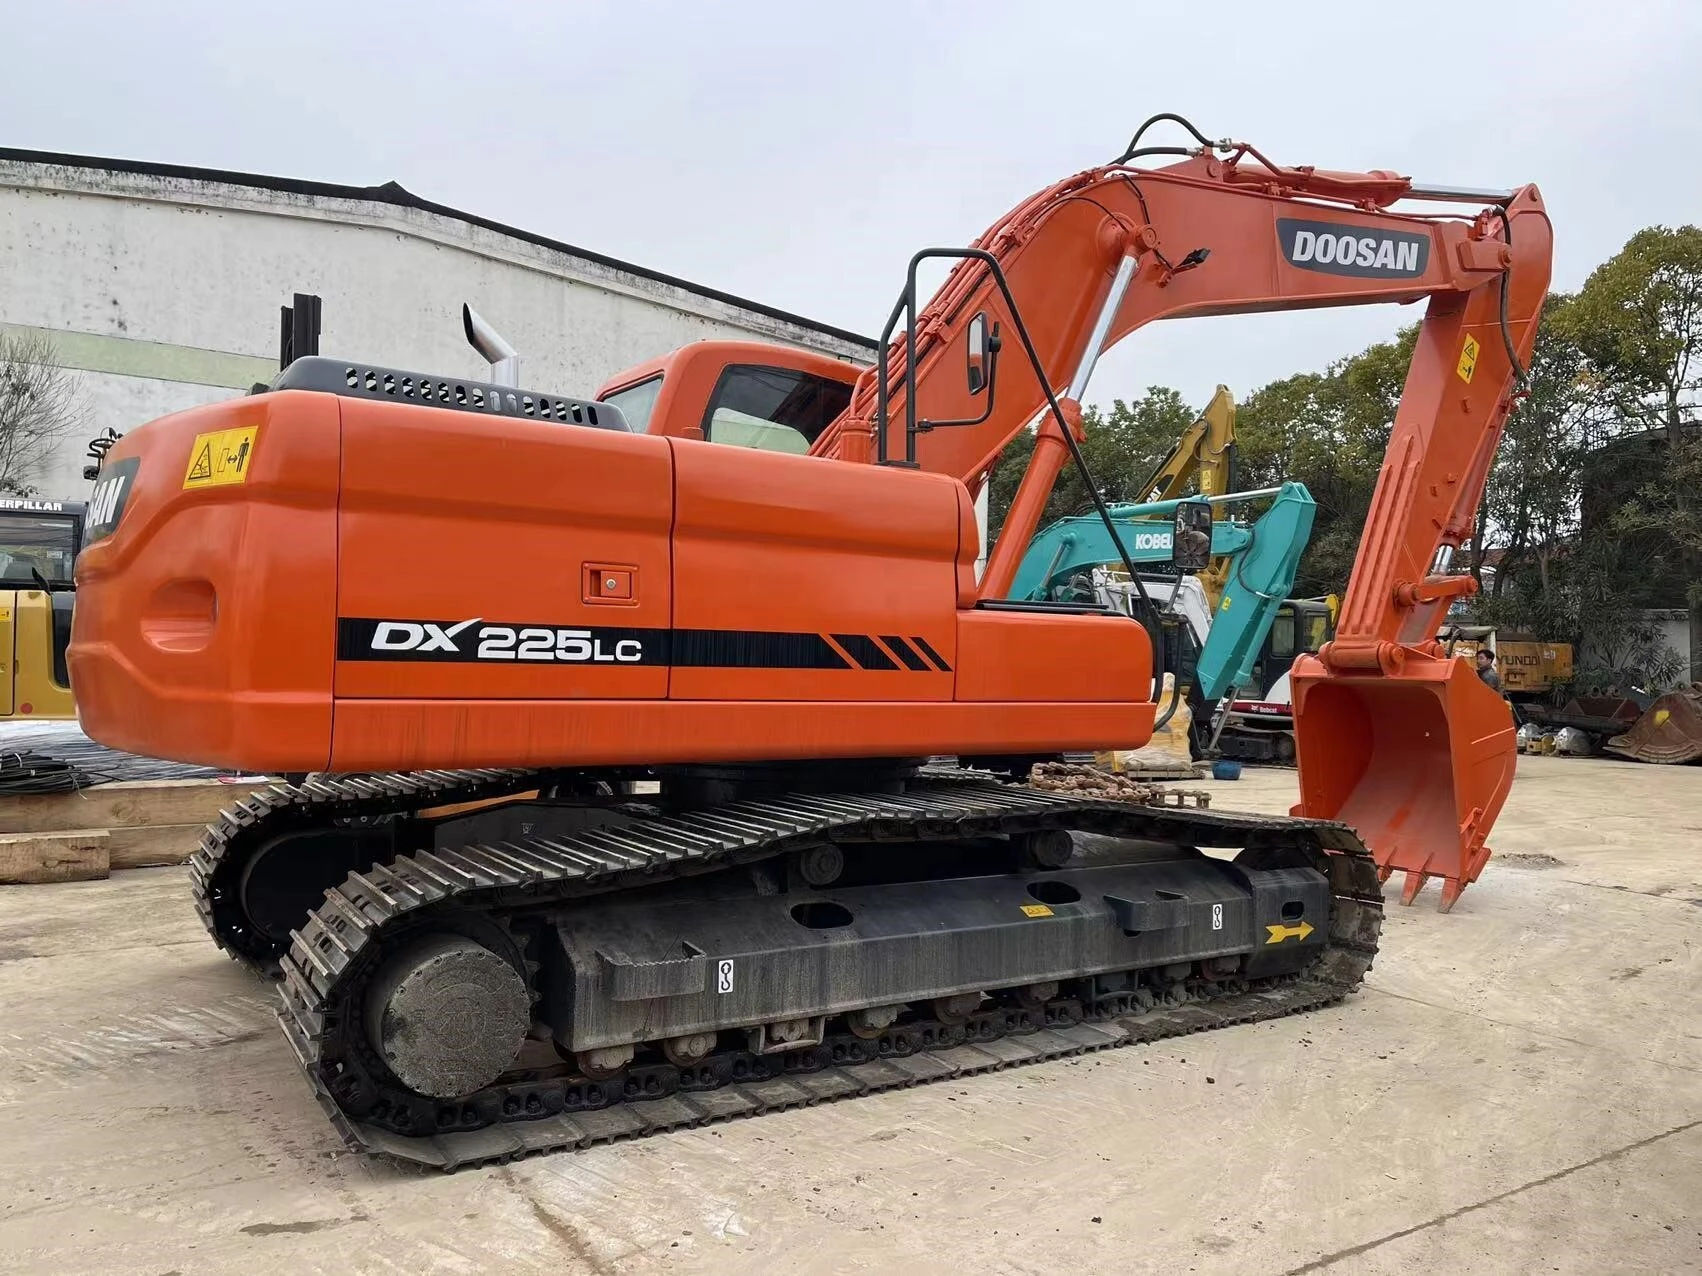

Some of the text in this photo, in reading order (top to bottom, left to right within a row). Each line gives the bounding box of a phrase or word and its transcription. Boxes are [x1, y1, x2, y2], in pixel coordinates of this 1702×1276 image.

[1292, 230, 1419, 272] DOOSAN
[371, 617, 642, 662] DX 225LC
